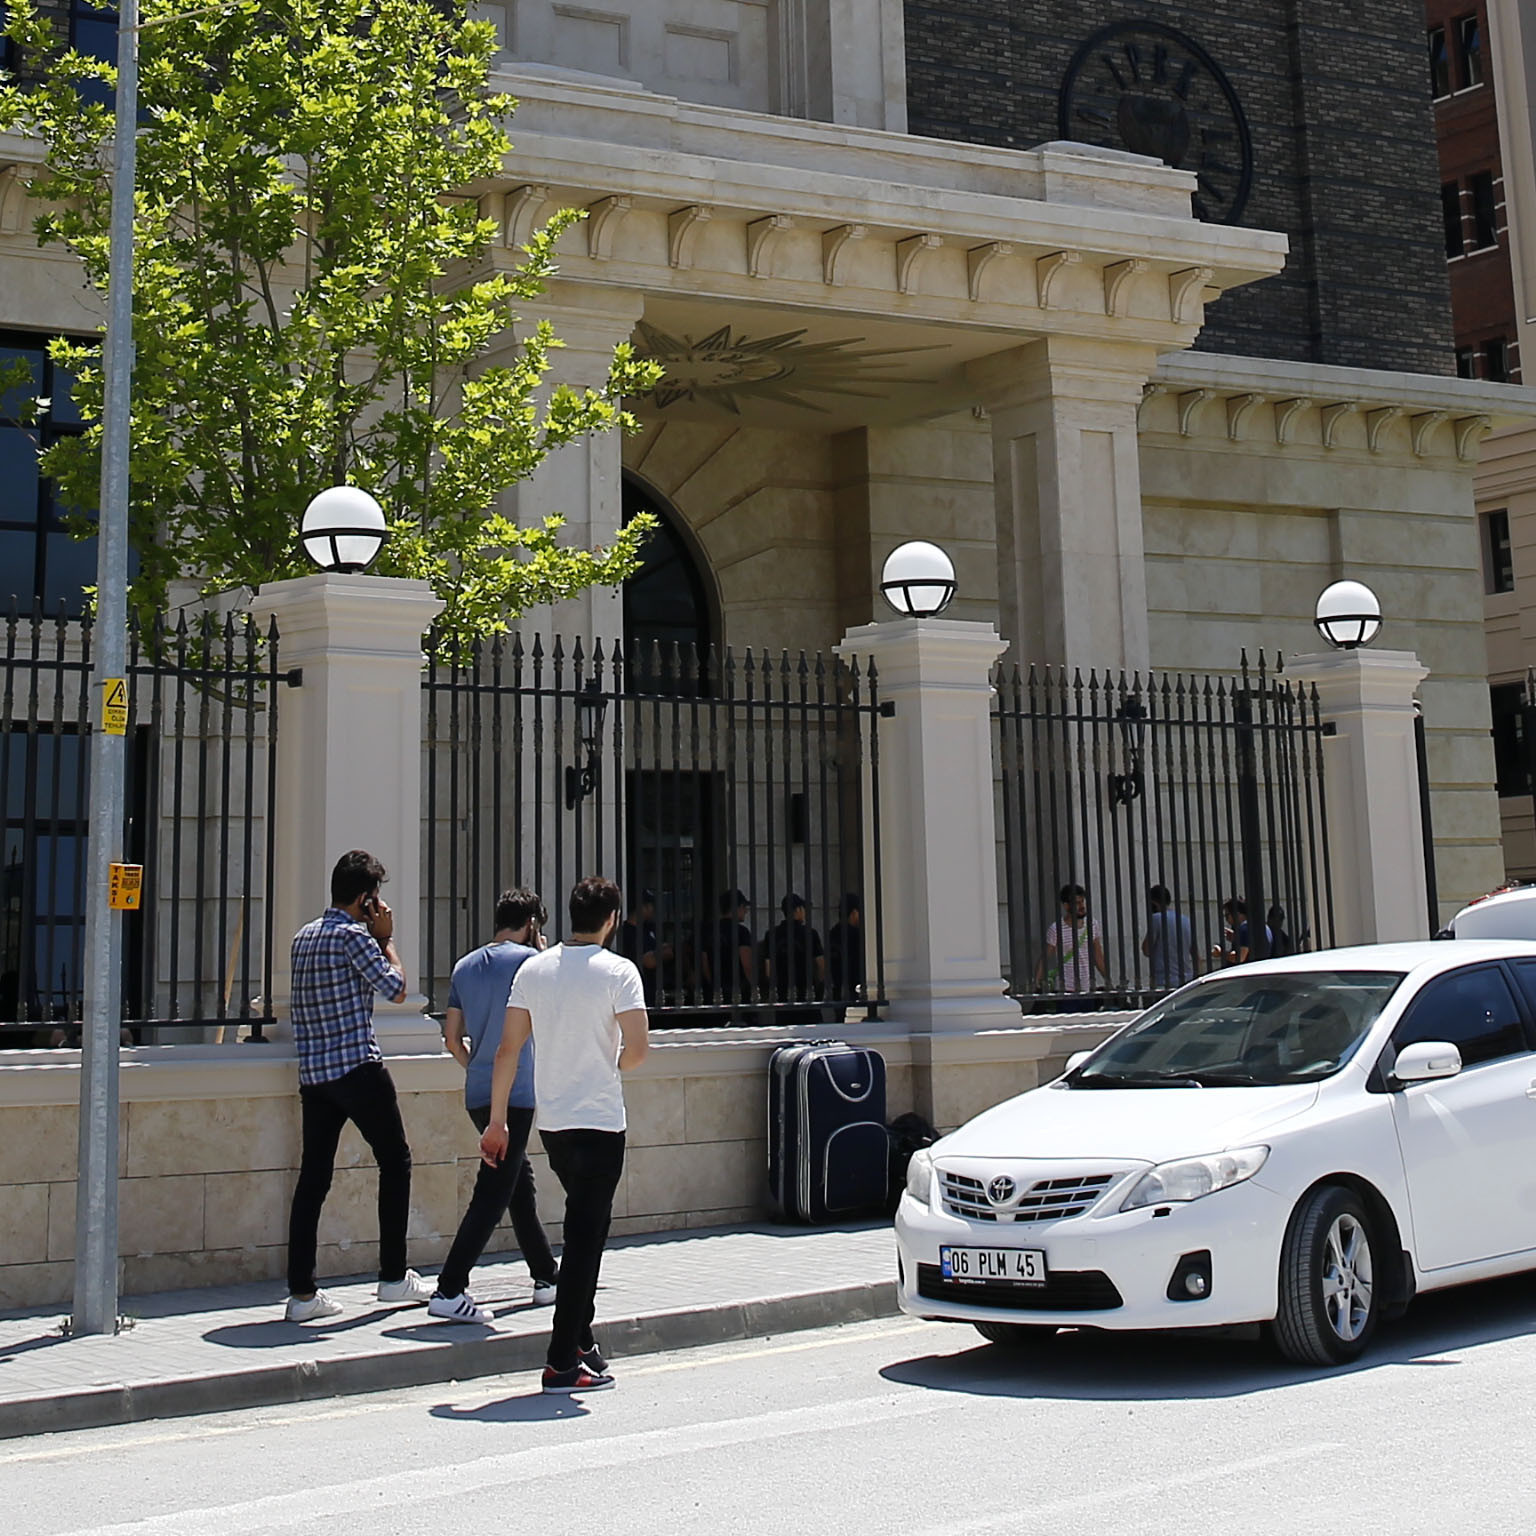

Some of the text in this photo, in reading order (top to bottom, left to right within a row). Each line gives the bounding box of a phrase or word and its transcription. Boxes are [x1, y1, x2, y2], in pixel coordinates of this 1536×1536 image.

[952, 1251, 1035, 1277] 06 PLM 45
